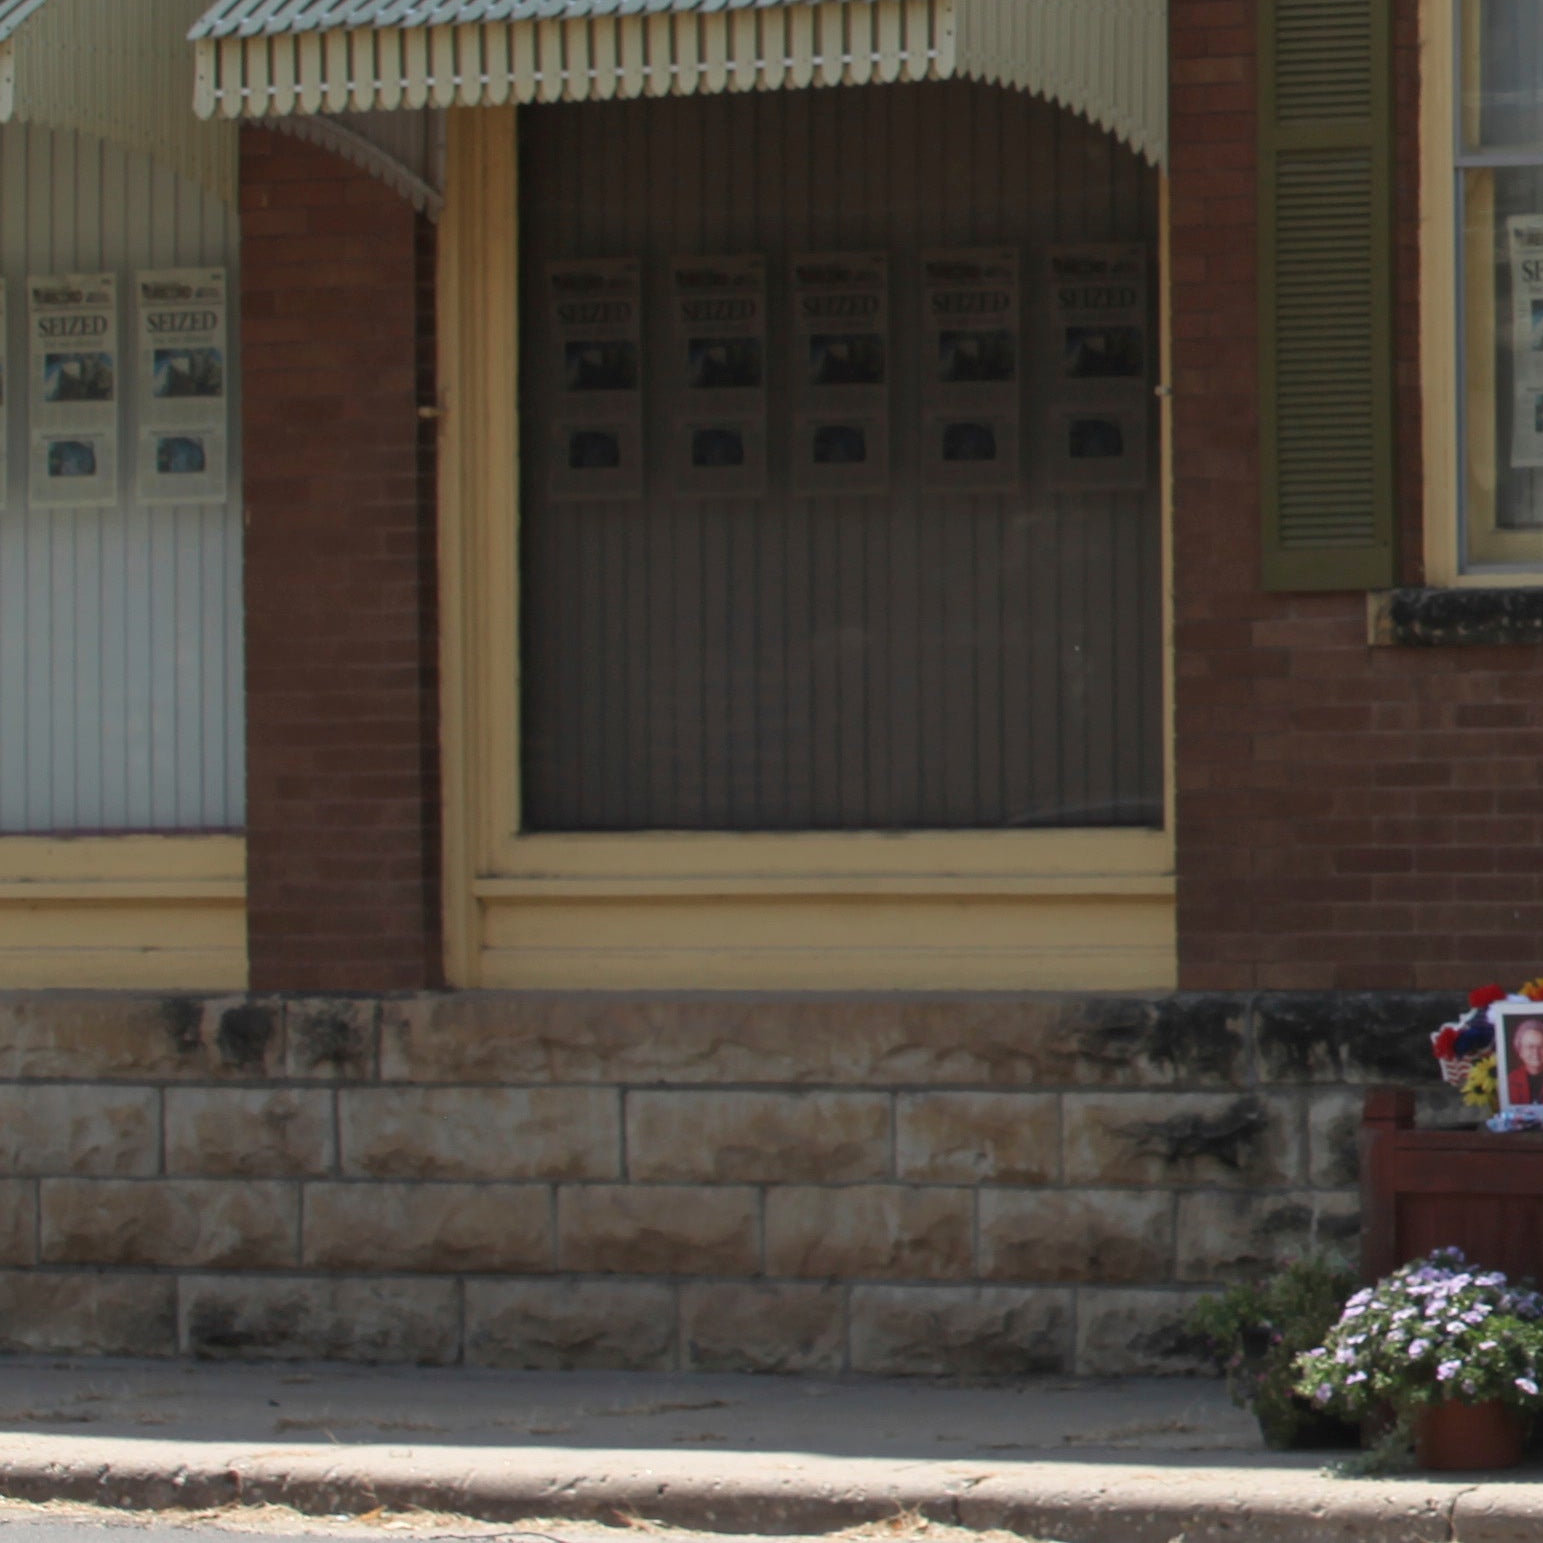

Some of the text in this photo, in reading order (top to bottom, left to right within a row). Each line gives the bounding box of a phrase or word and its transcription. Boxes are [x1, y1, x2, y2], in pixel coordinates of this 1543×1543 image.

[802, 295, 880, 318] SEIZED
[38, 314, 108, 338] SEIZED
[147, 310, 218, 334] SEIZED
